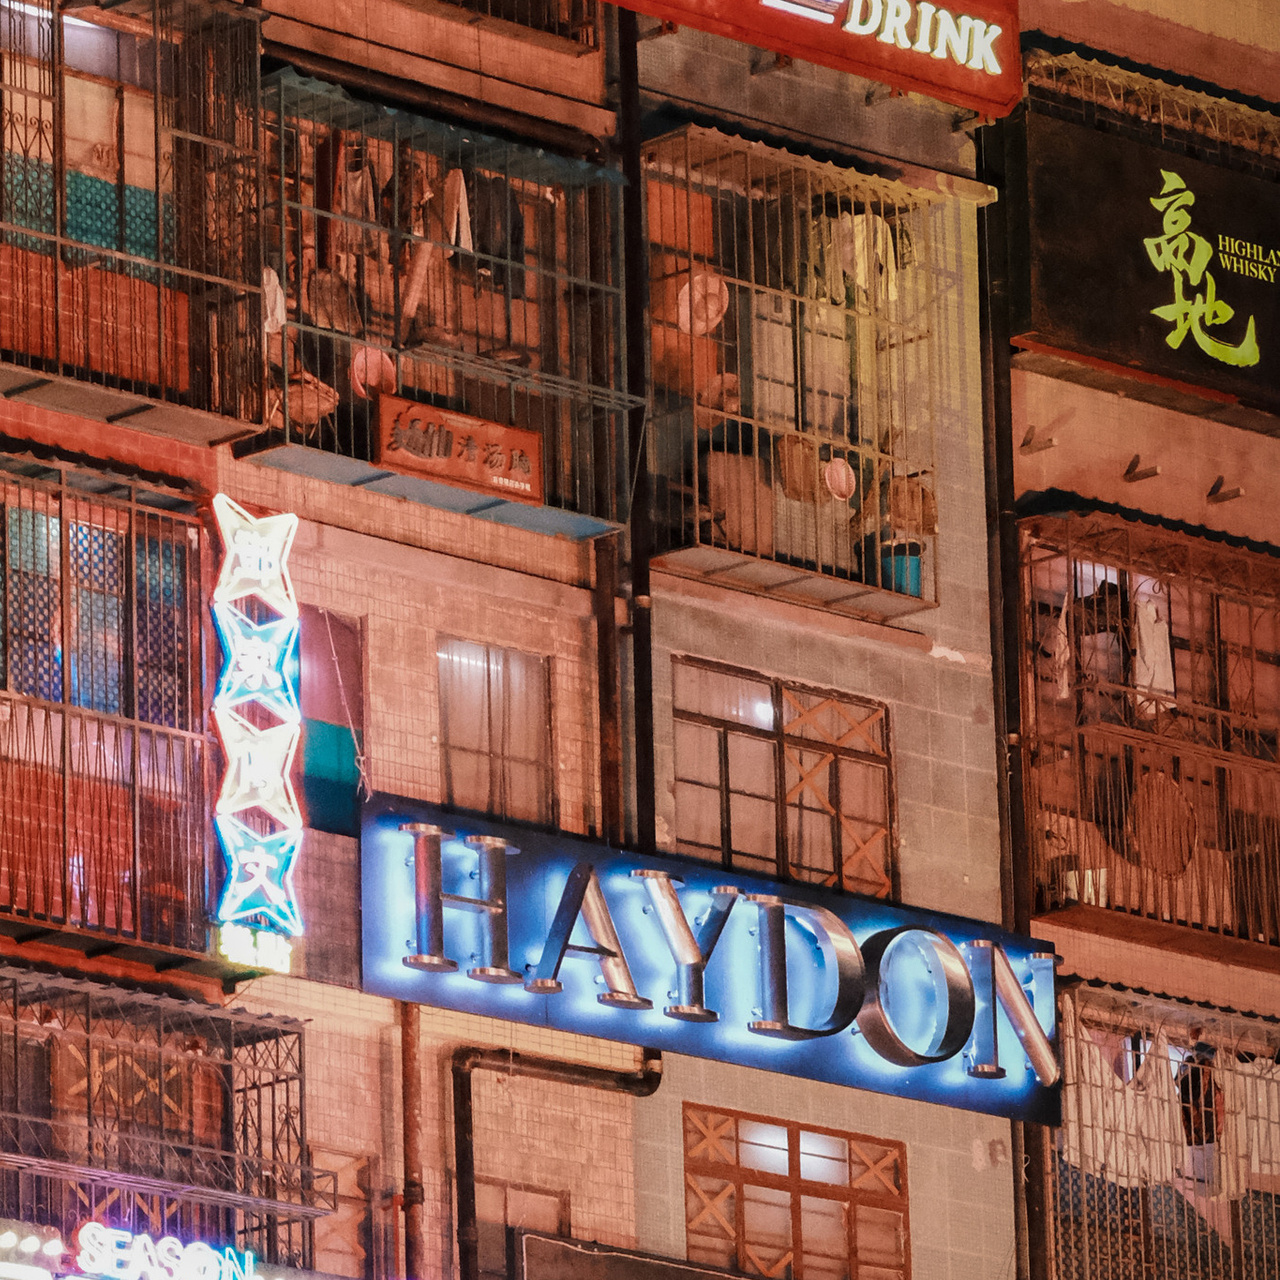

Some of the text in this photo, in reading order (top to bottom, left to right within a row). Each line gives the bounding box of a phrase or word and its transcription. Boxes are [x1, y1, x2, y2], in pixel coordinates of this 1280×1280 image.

[1143, 168, 1261, 368] 高地
[1218, 251, 1278, 284] WHISKY
[398, 822, 1065, 1088] HAYDON
